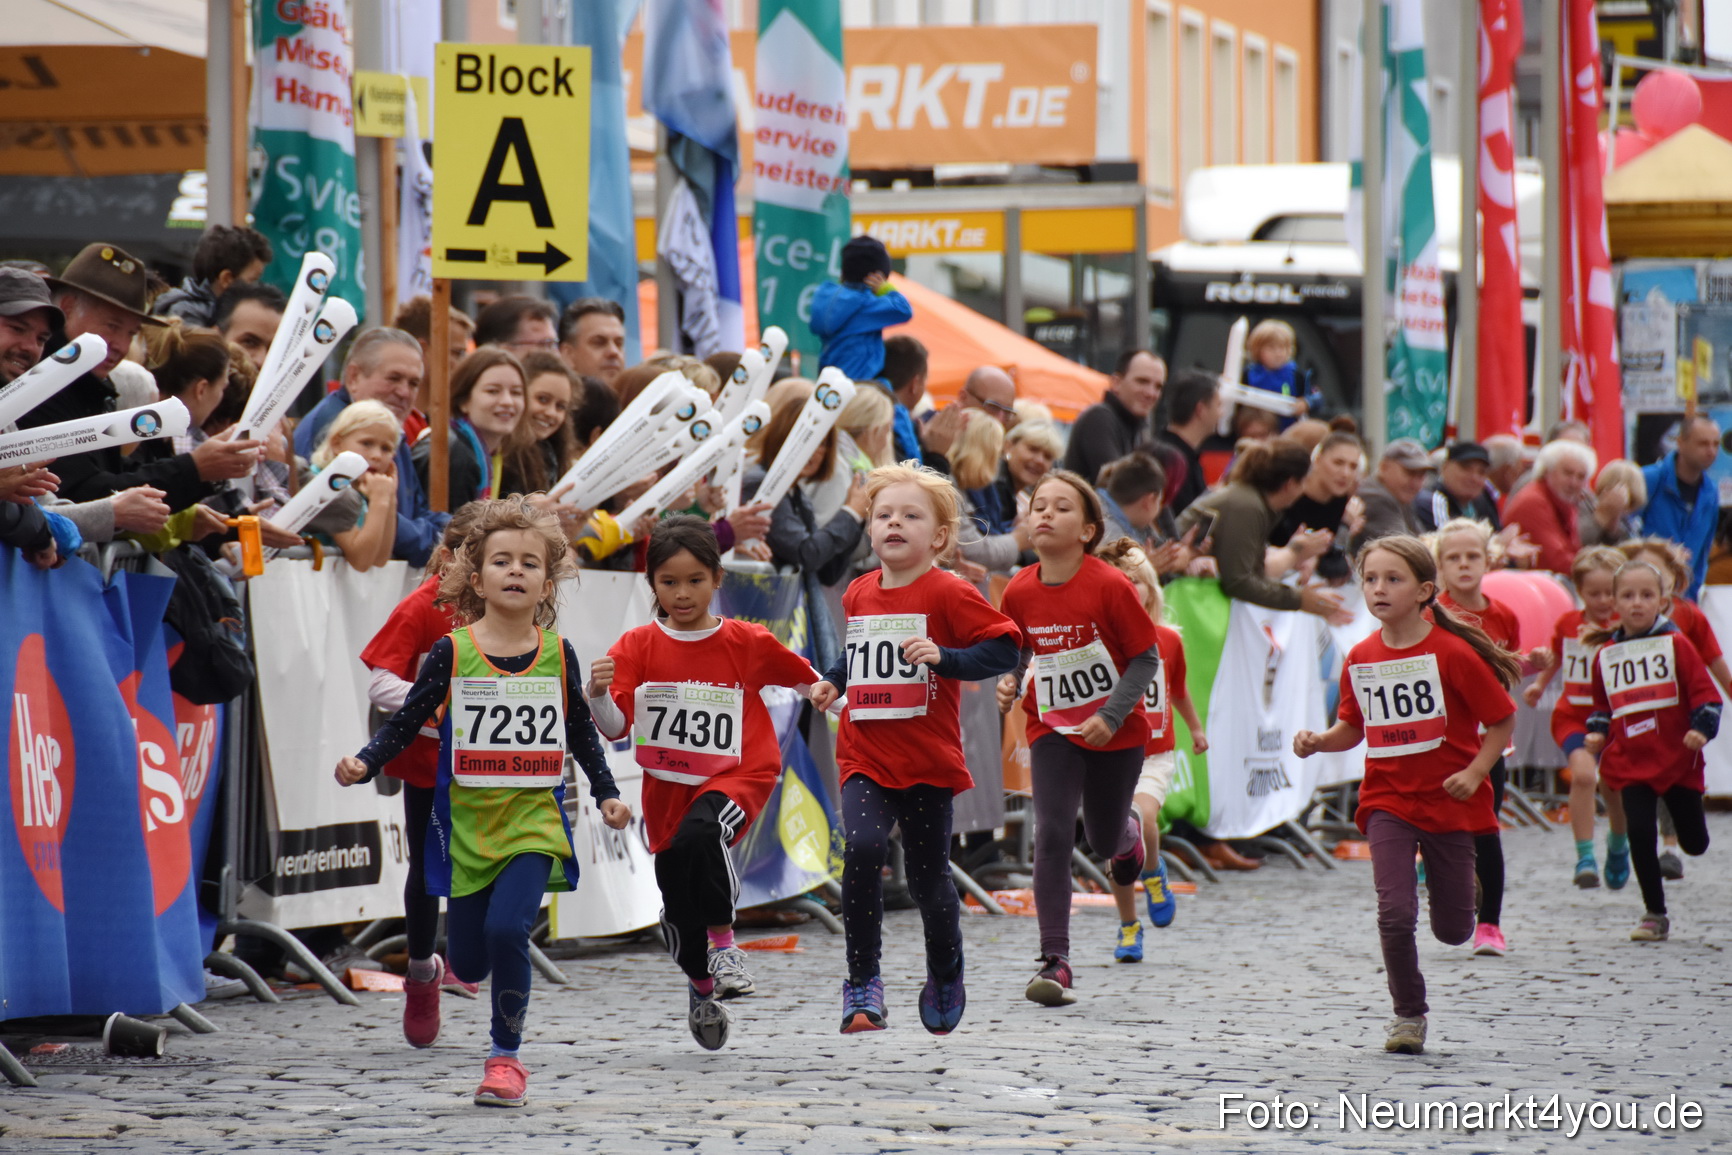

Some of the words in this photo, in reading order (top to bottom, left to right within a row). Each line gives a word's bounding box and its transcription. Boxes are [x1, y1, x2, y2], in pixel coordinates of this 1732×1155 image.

[455, 53, 574, 97] Block
[466, 116, 556, 229] A
[75, 434, 98, 446] BMW
[869, 618, 917, 632] BOCK
[847, 640, 919, 681] 7109
[1058, 646, 1100, 666] BOCK
[1380, 659, 1428, 677] BOCK
[1609, 653, 1669, 689] 7013
[461, 689, 499, 697] NeuerMarkt
[505, 681, 556, 695] BOCK
[1041, 662, 1113, 707] 7409
[684, 687, 735, 705] BOCK
[856, 690, 892, 705] Laura
[1362, 679, 1436, 721] 7168
[464, 704, 558, 746] 7232
[646, 705, 733, 750] 7430
[1381, 728, 1417, 744] Helga
[459, 755, 507, 771] Emma
[512, 756, 560, 775] Sophie
[655, 750, 690, 769] Fiona
